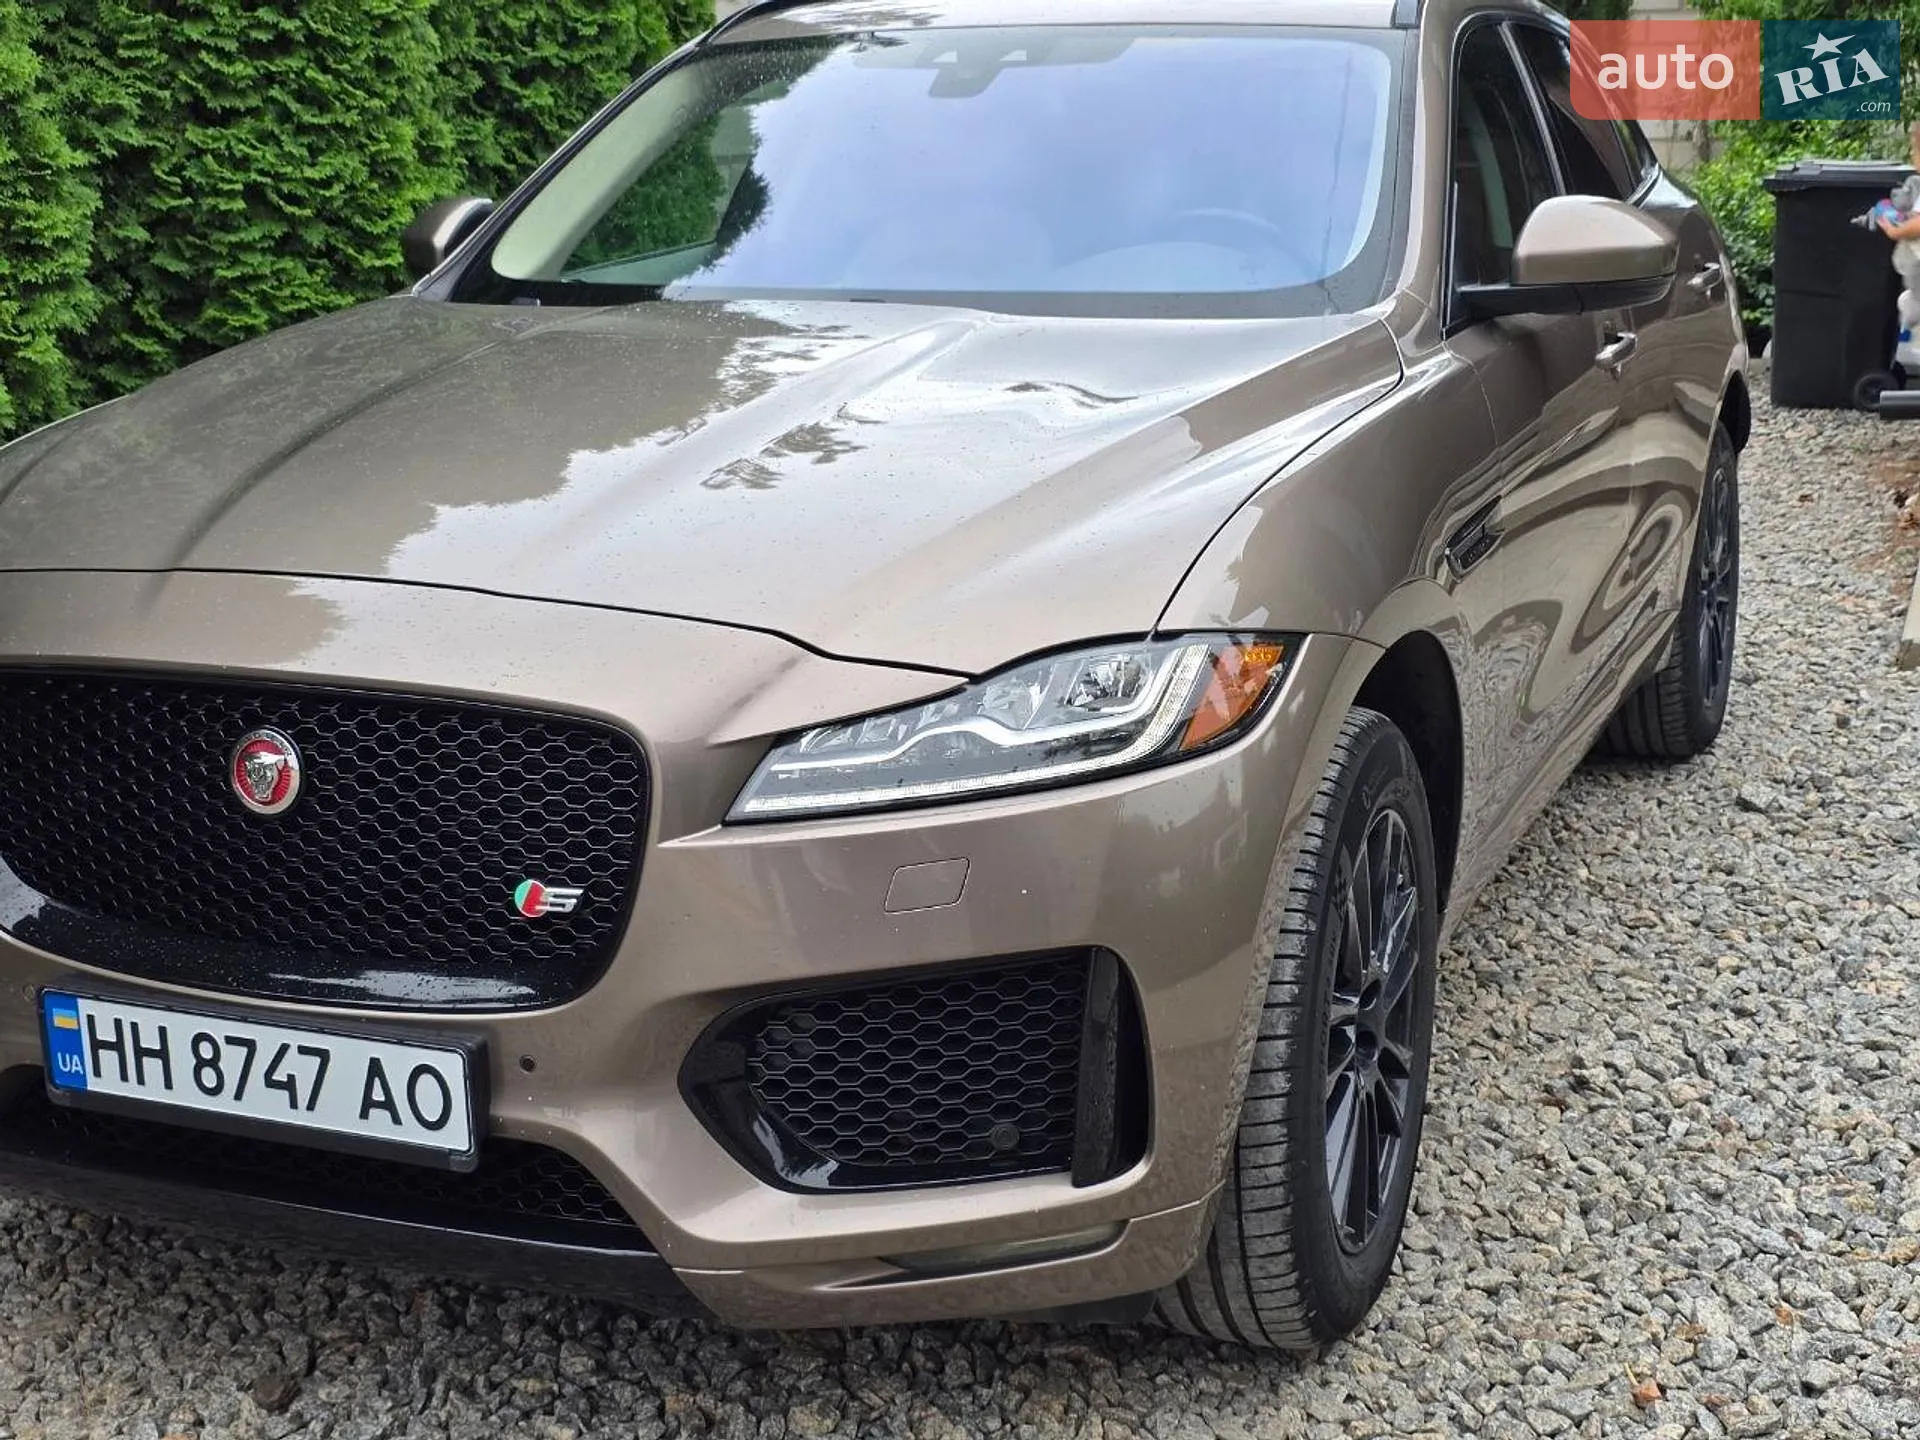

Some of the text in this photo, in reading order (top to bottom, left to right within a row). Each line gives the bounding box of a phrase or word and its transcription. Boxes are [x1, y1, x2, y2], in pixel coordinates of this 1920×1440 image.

[57, 1051, 84, 1075] UA
[86, 1013, 453, 1132] HH 8747 AO
